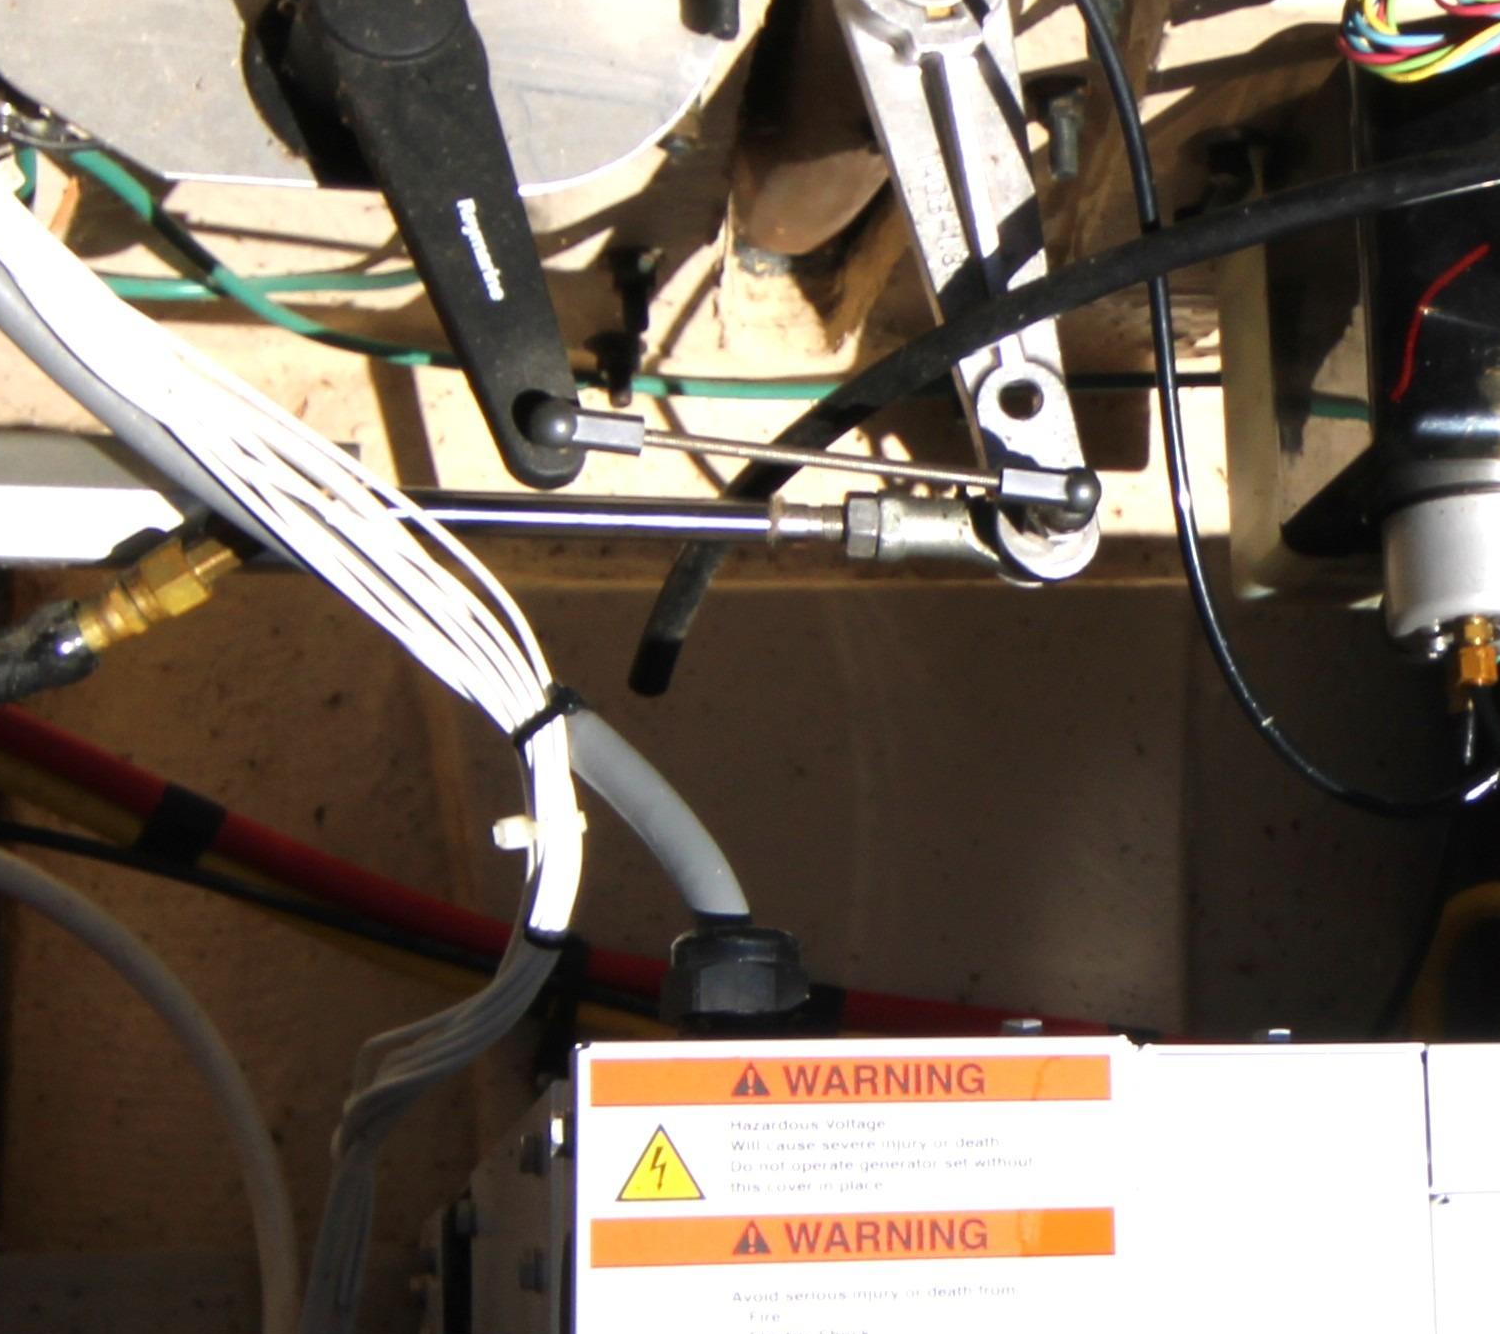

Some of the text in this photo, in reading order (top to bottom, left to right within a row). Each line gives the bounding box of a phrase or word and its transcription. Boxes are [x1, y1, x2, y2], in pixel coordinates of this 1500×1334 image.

[784, 1064, 985, 1097] WARNING
[730, 1118, 887, 1133] Hazardous Voltage
[730, 1139, 762, 1151] Will
[765, 1140, 817, 1150] cause
[821, 1139, 877, 1150] severe
[881, 1137, 927, 1152] injury
[730, 1156, 1034, 1174] Do not operate generator set without
[730, 1181, 762, 1192] this
[766, 1182, 813, 1192] cover
[786, 1220, 987, 1252] WARNING
[731, 1290, 780, 1302] Avoid
[785, 1288, 848, 1301] serious
[852, 1287, 900, 1302] injury
[927, 1285, 973, 1298] death
[748, 1311, 782, 1323] Fire
